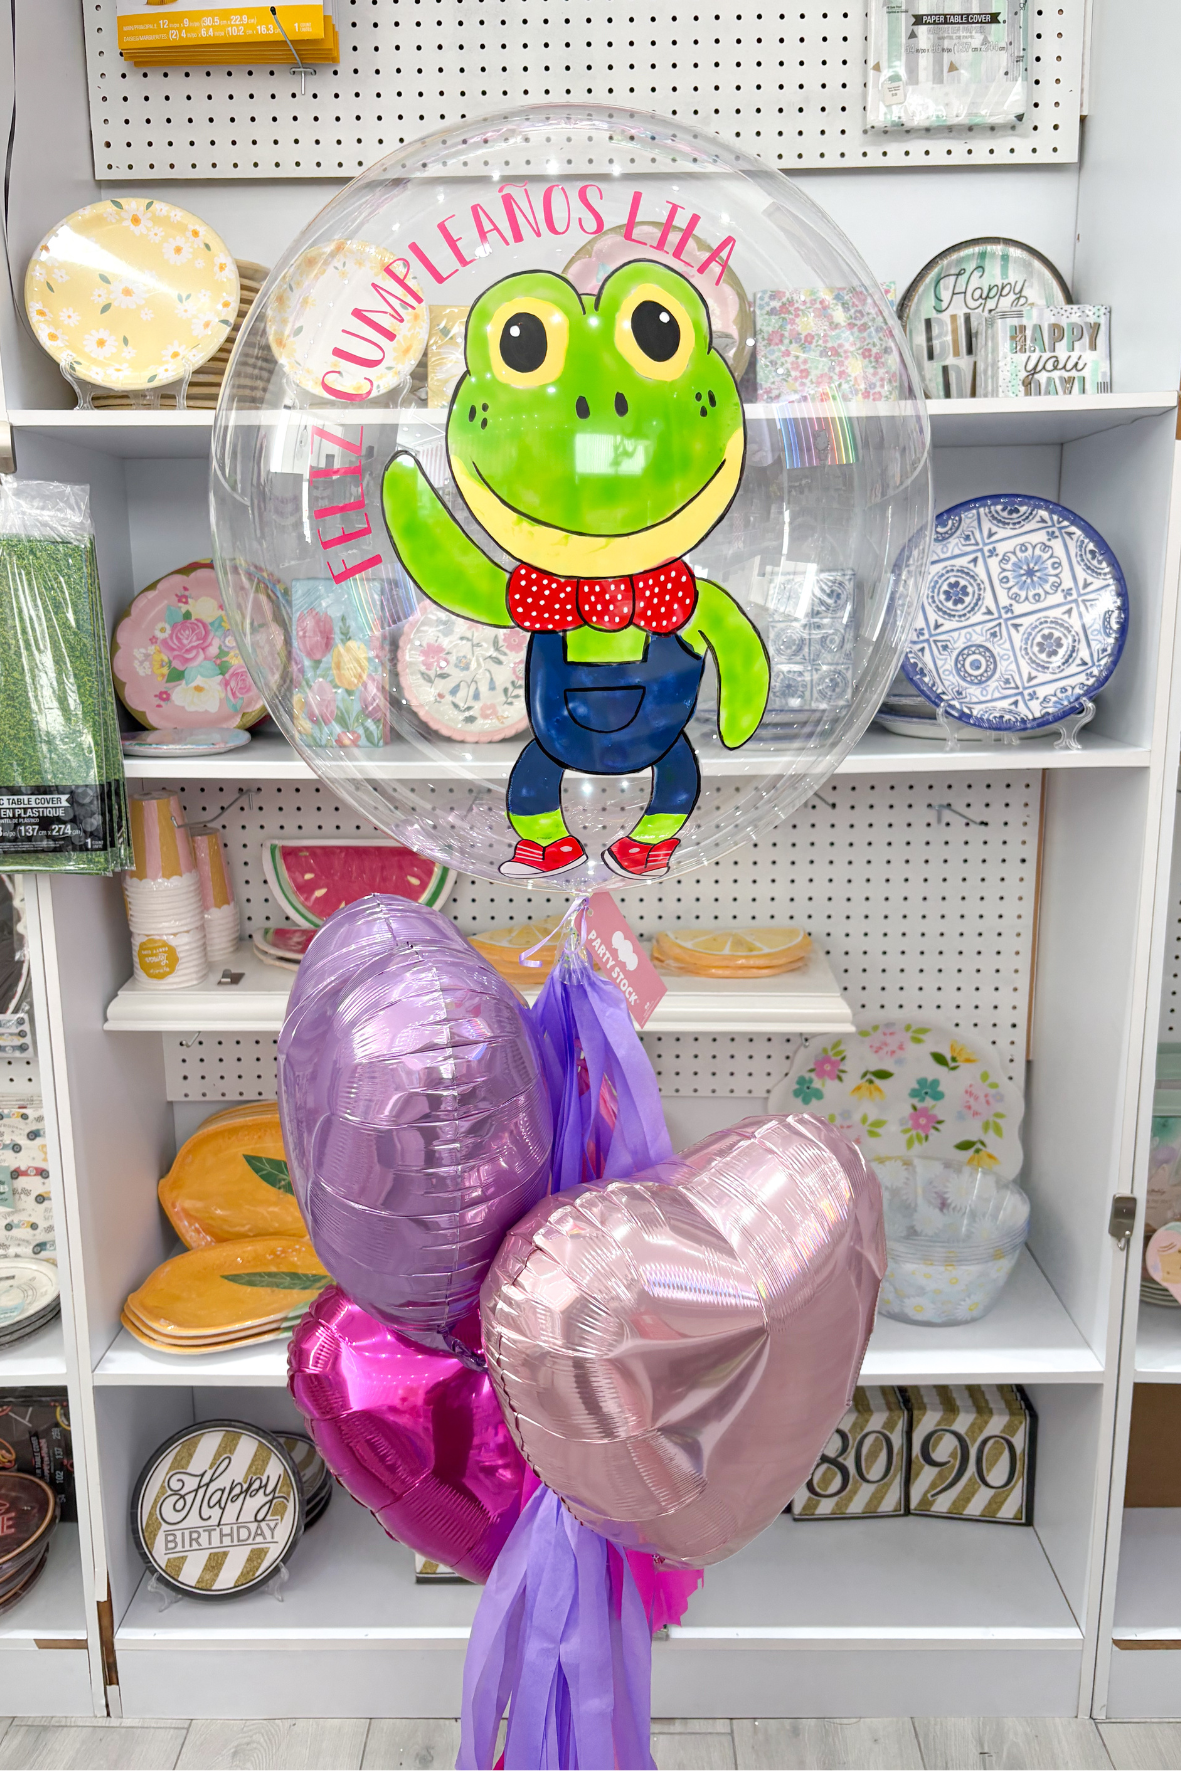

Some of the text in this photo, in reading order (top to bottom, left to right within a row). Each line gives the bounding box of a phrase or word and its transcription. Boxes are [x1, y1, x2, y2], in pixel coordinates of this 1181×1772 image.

[159, 19, 168, 28] 12
[183, 18, 189, 27] 9
[230, 15, 247, 24] 22.9
[294, 22, 299, 32] 1
[922, 14, 991, 23] PAPER TABLE COVER
[169, 30, 179, 41] (2)
[181, 29, 186, 38] 4
[201, 28, 213, 38] 6.4
[225, 26, 244, 37] (10.2
[257, 24, 274, 35] 16.3
[933, 265, 1028, 313] Happy
[1008, 321, 1101, 354] HAPPY
[1021, 354, 1088, 388] you
[309, 180, 738, 585] FELIZ CUMPLEAÑOS LILA
[1022, 375, 1087, 398] DAY!
[7, 797, 33, 806] TABLE
[34, 797, 62, 805] COVER
[1, 807, 66, 818] EN PLASTIQUE
[17, 825, 39, 838] (137
[51, 824, 71, 836] 274
[85, 838, 92, 849] 1
[587, 929, 639, 1006] PARTY STOCK
[54, 1446, 63, 1459] 137
[806, 1428, 894, 1499] 80
[920, 1427, 1018, 1500] 90
[55, 1470, 64, 1484] 102
[158, 1454, 290, 1528] Happy
[164, 1522, 279, 1553] BIRTHDAY
